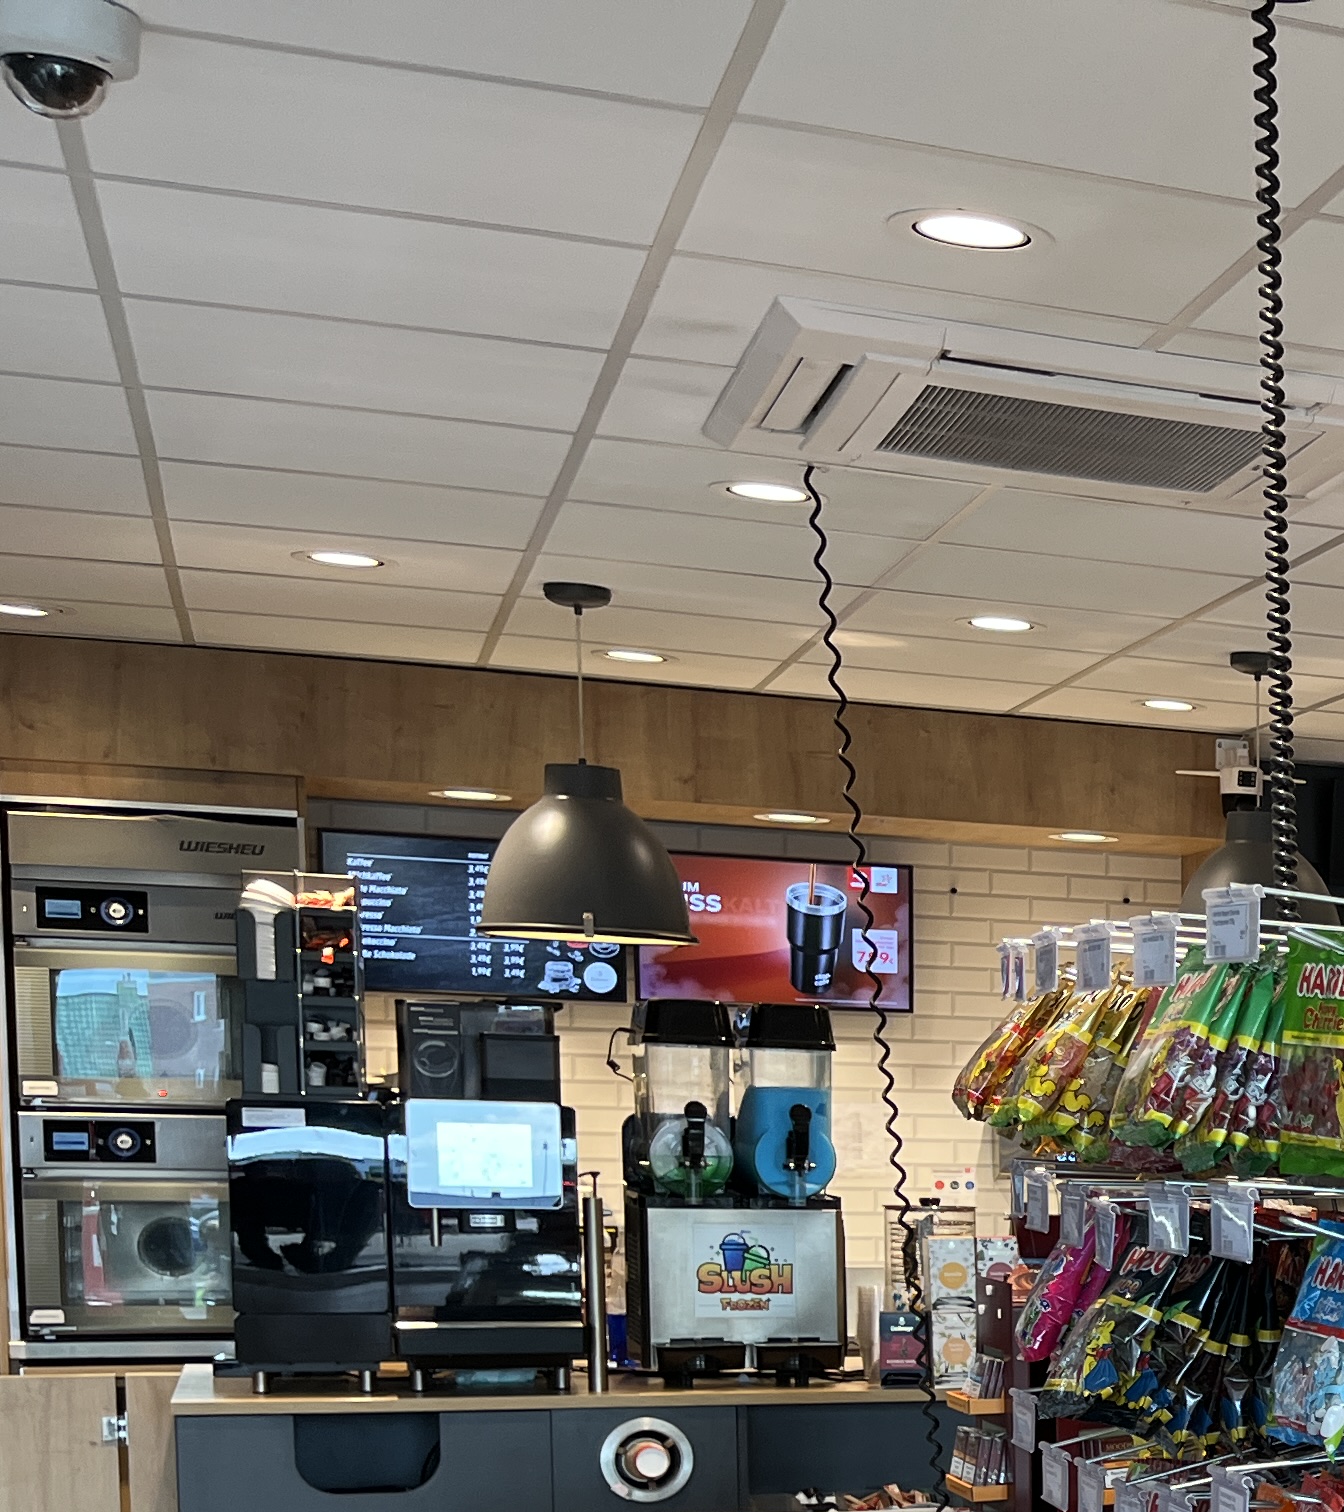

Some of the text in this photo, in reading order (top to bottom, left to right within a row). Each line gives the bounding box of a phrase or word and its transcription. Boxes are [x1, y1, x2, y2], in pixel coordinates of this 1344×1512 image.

[179, 839, 264, 856] WIESHEU
[697, 1263, 793, 1295] SLUSH
[720, 1298, 772, 1312] FROZEN
